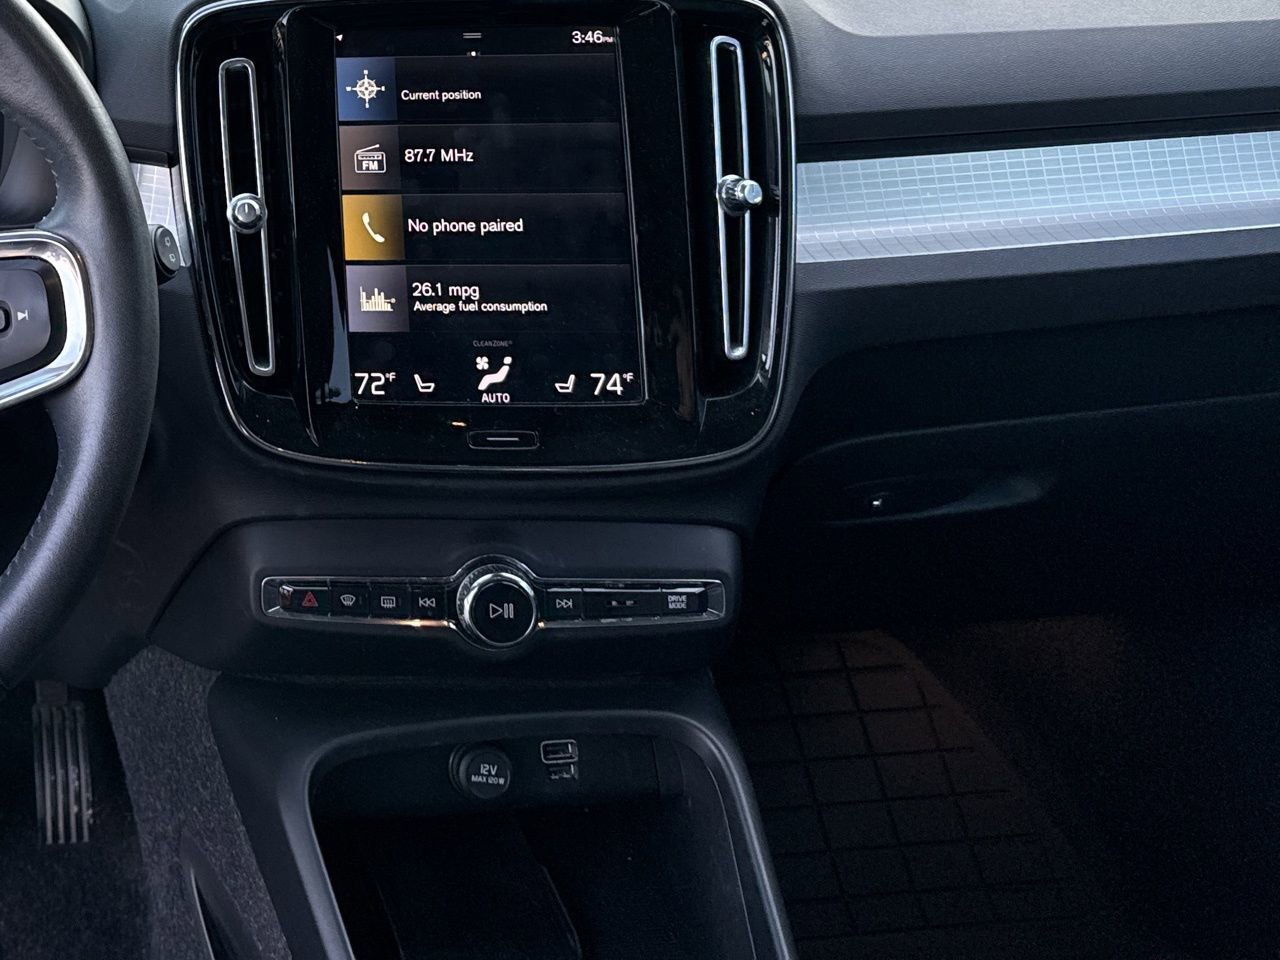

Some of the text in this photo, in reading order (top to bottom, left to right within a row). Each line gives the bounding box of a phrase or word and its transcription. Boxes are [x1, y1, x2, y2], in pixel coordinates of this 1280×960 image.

[401, 88, 482, 105] Current position
[404, 148, 474, 163] 87.7 MHz
[361, 159, 379, 171] FM
[408, 217, 524, 236] No phone paired
[412, 282, 480, 300] 26.1 mpg
[413, 300, 548, 314] Average fuel consumption
[481, 392, 511, 403] AUTO
[480, 763, 498, 775] 12V
[471, 774, 487, 783] MAX
